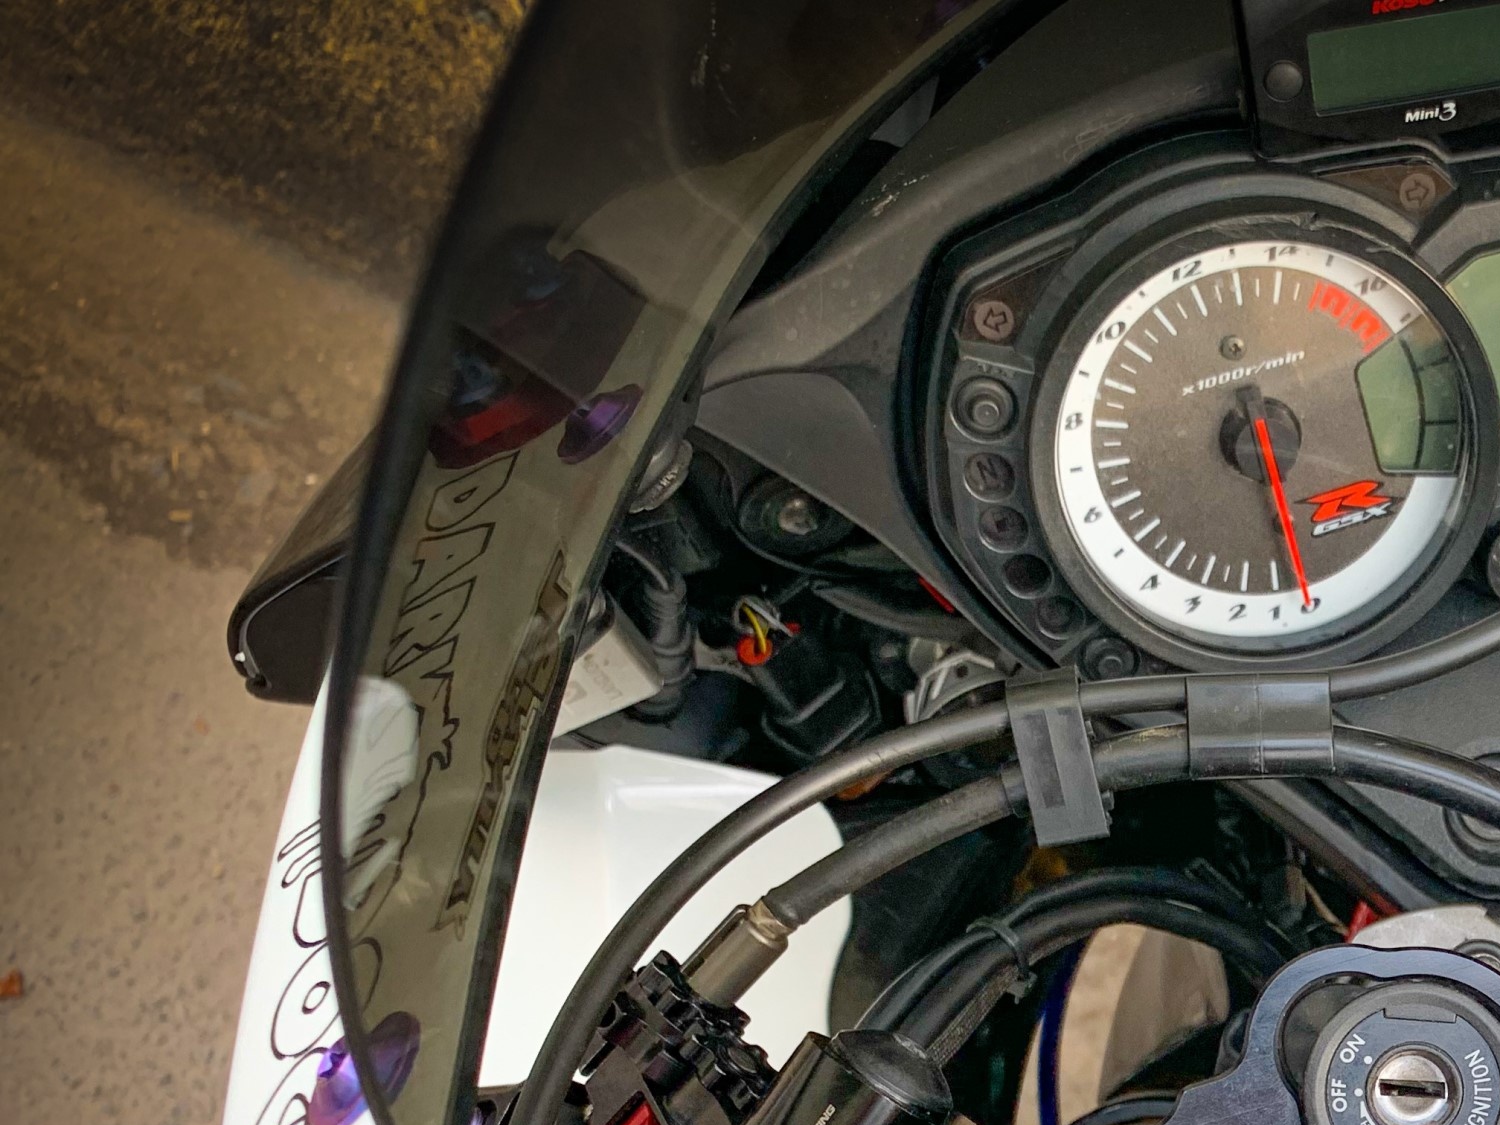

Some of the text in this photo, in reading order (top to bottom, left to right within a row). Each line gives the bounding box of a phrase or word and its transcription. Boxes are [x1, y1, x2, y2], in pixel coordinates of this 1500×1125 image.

[1265, 246, 1299, 261] 14
[1172, 260, 1203, 282] 12
[1355, 277, 1388, 296] 16
[1096, 320, 1127, 345] 10
[1065, 413, 1083, 431] 8
[1085, 506, 1102, 524] 6
[1312, 504, 1392, 537] GSX
[1140, 574, 1161, 591] 4
[1185, 596, 1203, 614] 3
[1228, 604, 1247, 621] 2
[1268, 606, 1282, 621] 1
[1339, 1034, 1366, 1064] ON
[1331, 1078, 1348, 1113] OFF
